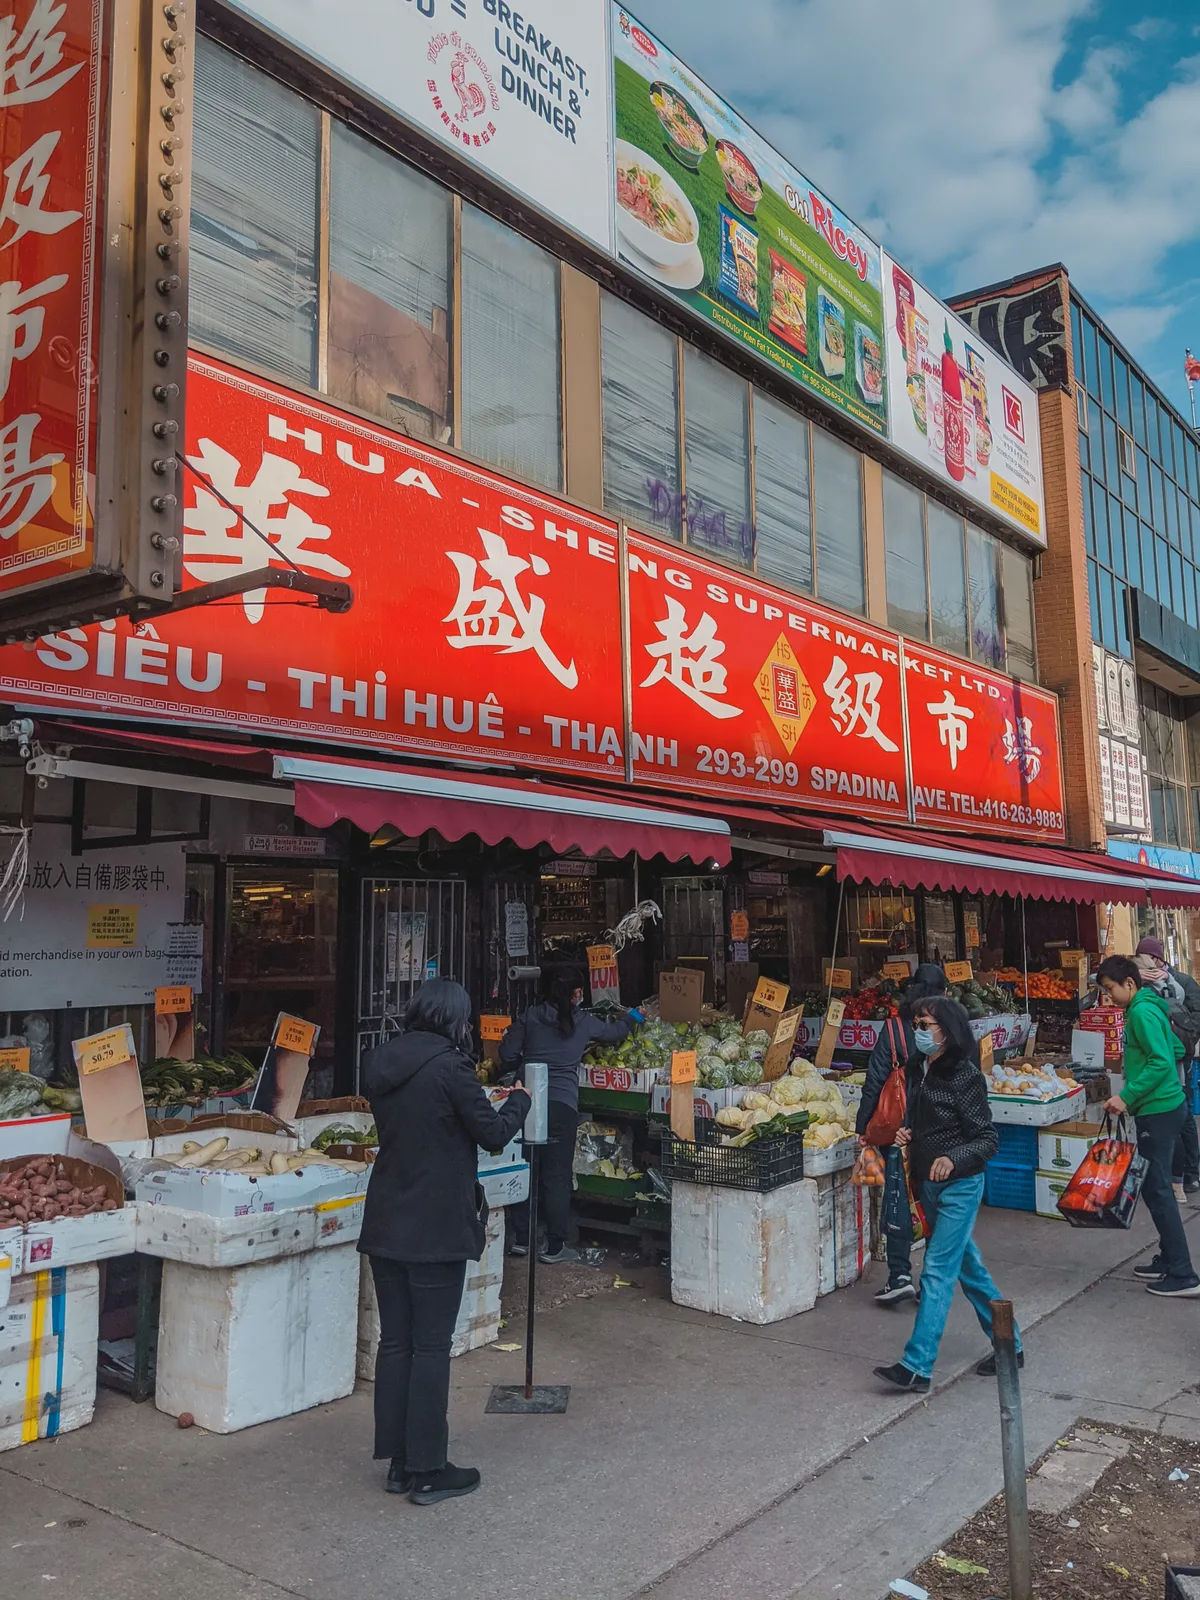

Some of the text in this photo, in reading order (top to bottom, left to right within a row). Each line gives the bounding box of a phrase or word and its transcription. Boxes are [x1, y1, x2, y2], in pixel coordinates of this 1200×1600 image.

[494, 26, 582, 119] LUNCH &
[501, 64, 577, 144] DINNER
[785, 184, 868, 282] Oh! Ricey
[777, 227, 873, 318] The finest rice for the finest noodles
[743, 328, 757, 346] Kien
[756, 337, 766, 352] Fat
[766, 345, 786, 367] Trading
[268, 413, 442, 498] HUA
[501, 504, 693, 592] SHENG
[706, 582, 953, 683] SUPERMARKET
[961, 674, 1008, 702] LTD.
[776, 641, 791, 660] HS
[777, 671, 797, 711] 華盛
[404, 692, 505, 739] HUÊ
[696, 745, 799, 787] 293-299
[810, 766, 899, 804] SPADINA
[273, 838, 297, 846] Maintain
[12, 949, 83, 961] merchandise
[86, 949, 95, 960] in
[96, 951, 121, 964] your
[122, 951, 142, 959] own
[284, 1033, 302, 1044] $1.39
[842, 1029, 874, 1045] 百利
[92, 1049, 114, 1065] $0.79
[593, 1070, 628, 1088] 百利
